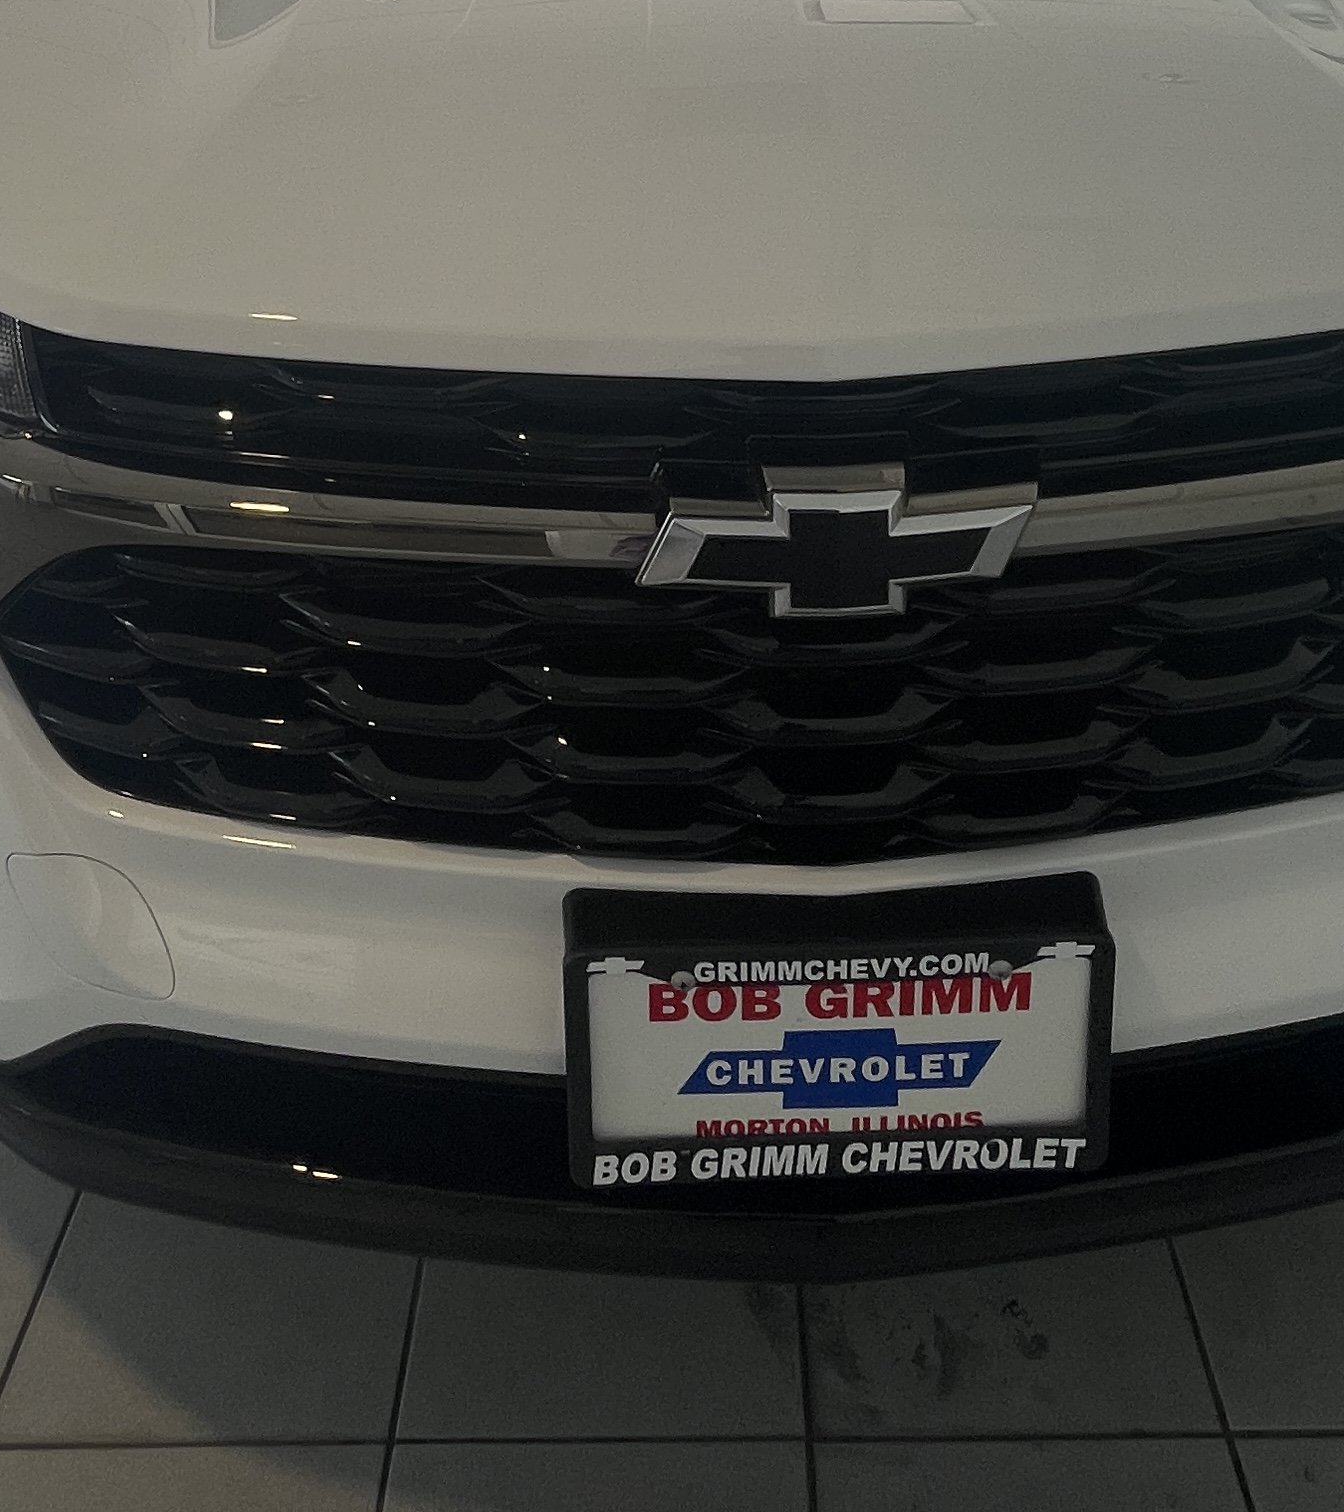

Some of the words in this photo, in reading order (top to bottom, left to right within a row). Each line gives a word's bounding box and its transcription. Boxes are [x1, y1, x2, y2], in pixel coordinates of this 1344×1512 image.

[694, 952, 990, 982] GRIMMCHEVY.COM
[648, 982, 783, 1023] BOB
[805, 972, 1032, 1019] GRIMM
[706, 1053, 971, 1085] CHEVROLET
[696, 1117, 830, 1138] MORTON
[852, 1111, 984, 1134] ILLINOIS
[593, 1151, 677, 1186] BOB
[691, 1144, 829, 1180] GRIMM
[843, 1138, 1086, 1174] CHEVROLET
